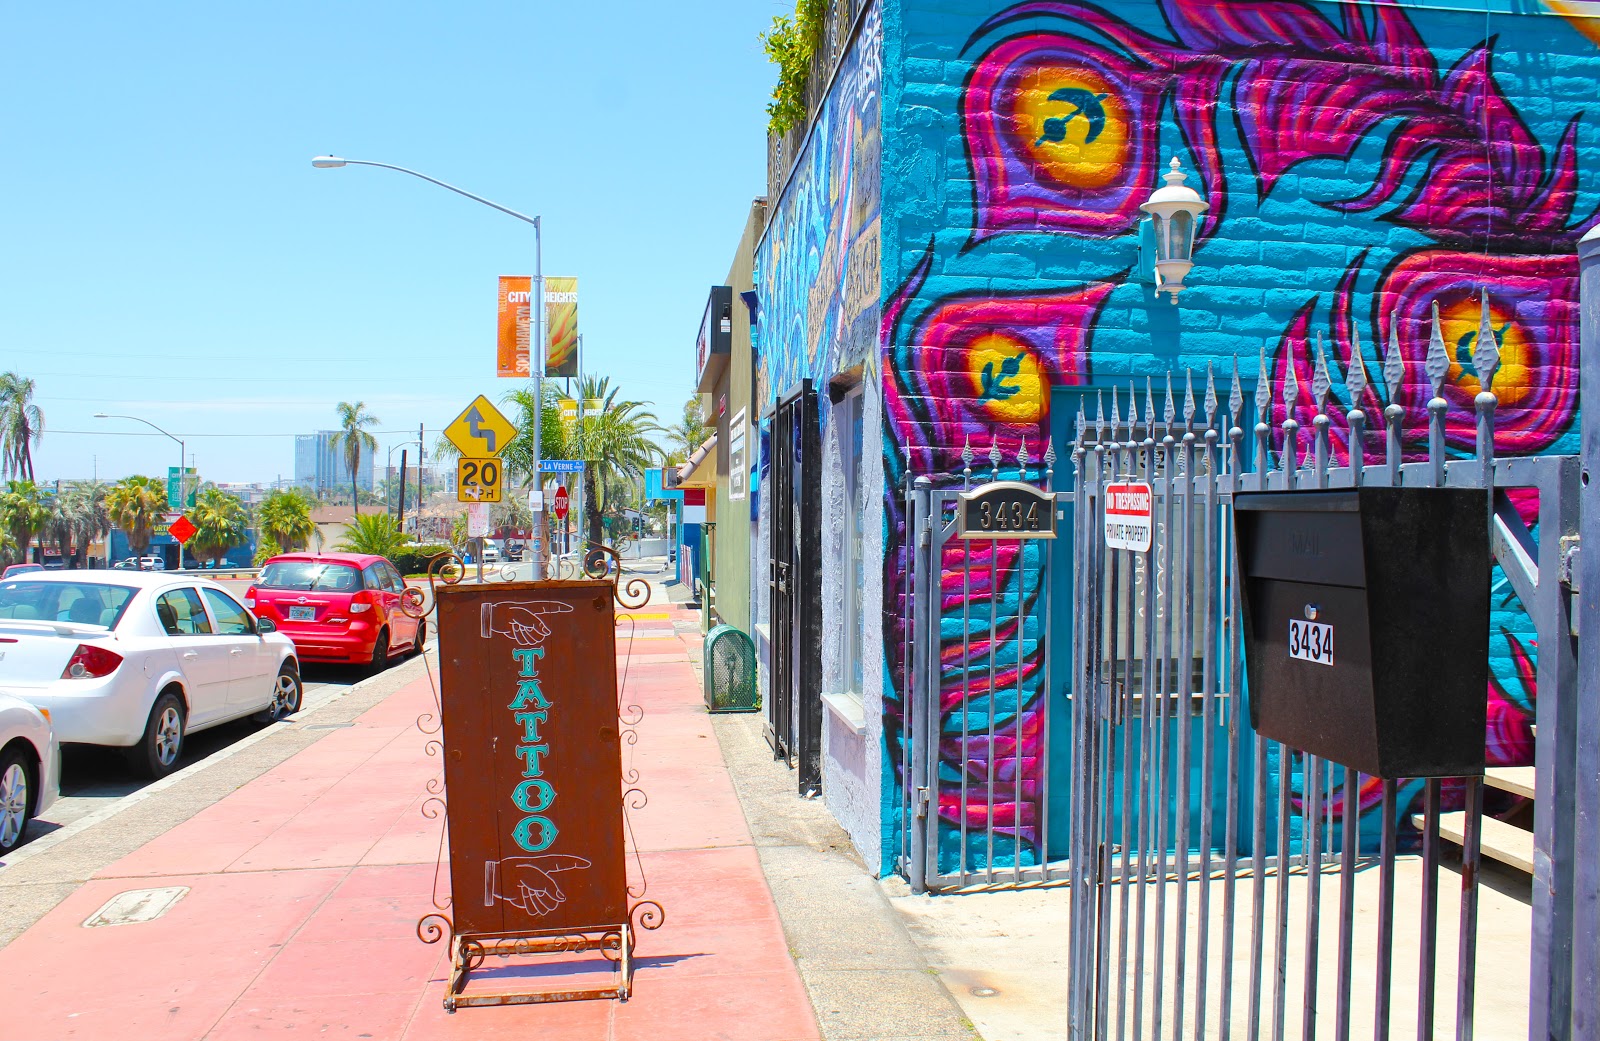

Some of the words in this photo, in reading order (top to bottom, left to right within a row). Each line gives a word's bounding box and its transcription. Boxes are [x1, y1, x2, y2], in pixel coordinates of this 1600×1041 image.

[508, 291, 531, 303] CITY
[544, 291, 578, 303] HEIGHTS
[563, 409, 577, 417] CITY
[462, 462, 498, 487] 20
[544, 462, 552, 470] LA
[553, 462, 574, 470] VERNE
[555, 496, 568, 510] STOP
[1106, 492, 1115, 510] NO
[1115, 492, 1149, 511] TRESPASSING
[980, 501, 1039, 529] 3434
[1106, 523, 1124, 540] PRIVATE
[1125, 524, 1149, 543] PROPERTY
[1290, 622, 1333, 663] 3434
[507, 645, 560, 853] TATTOO
